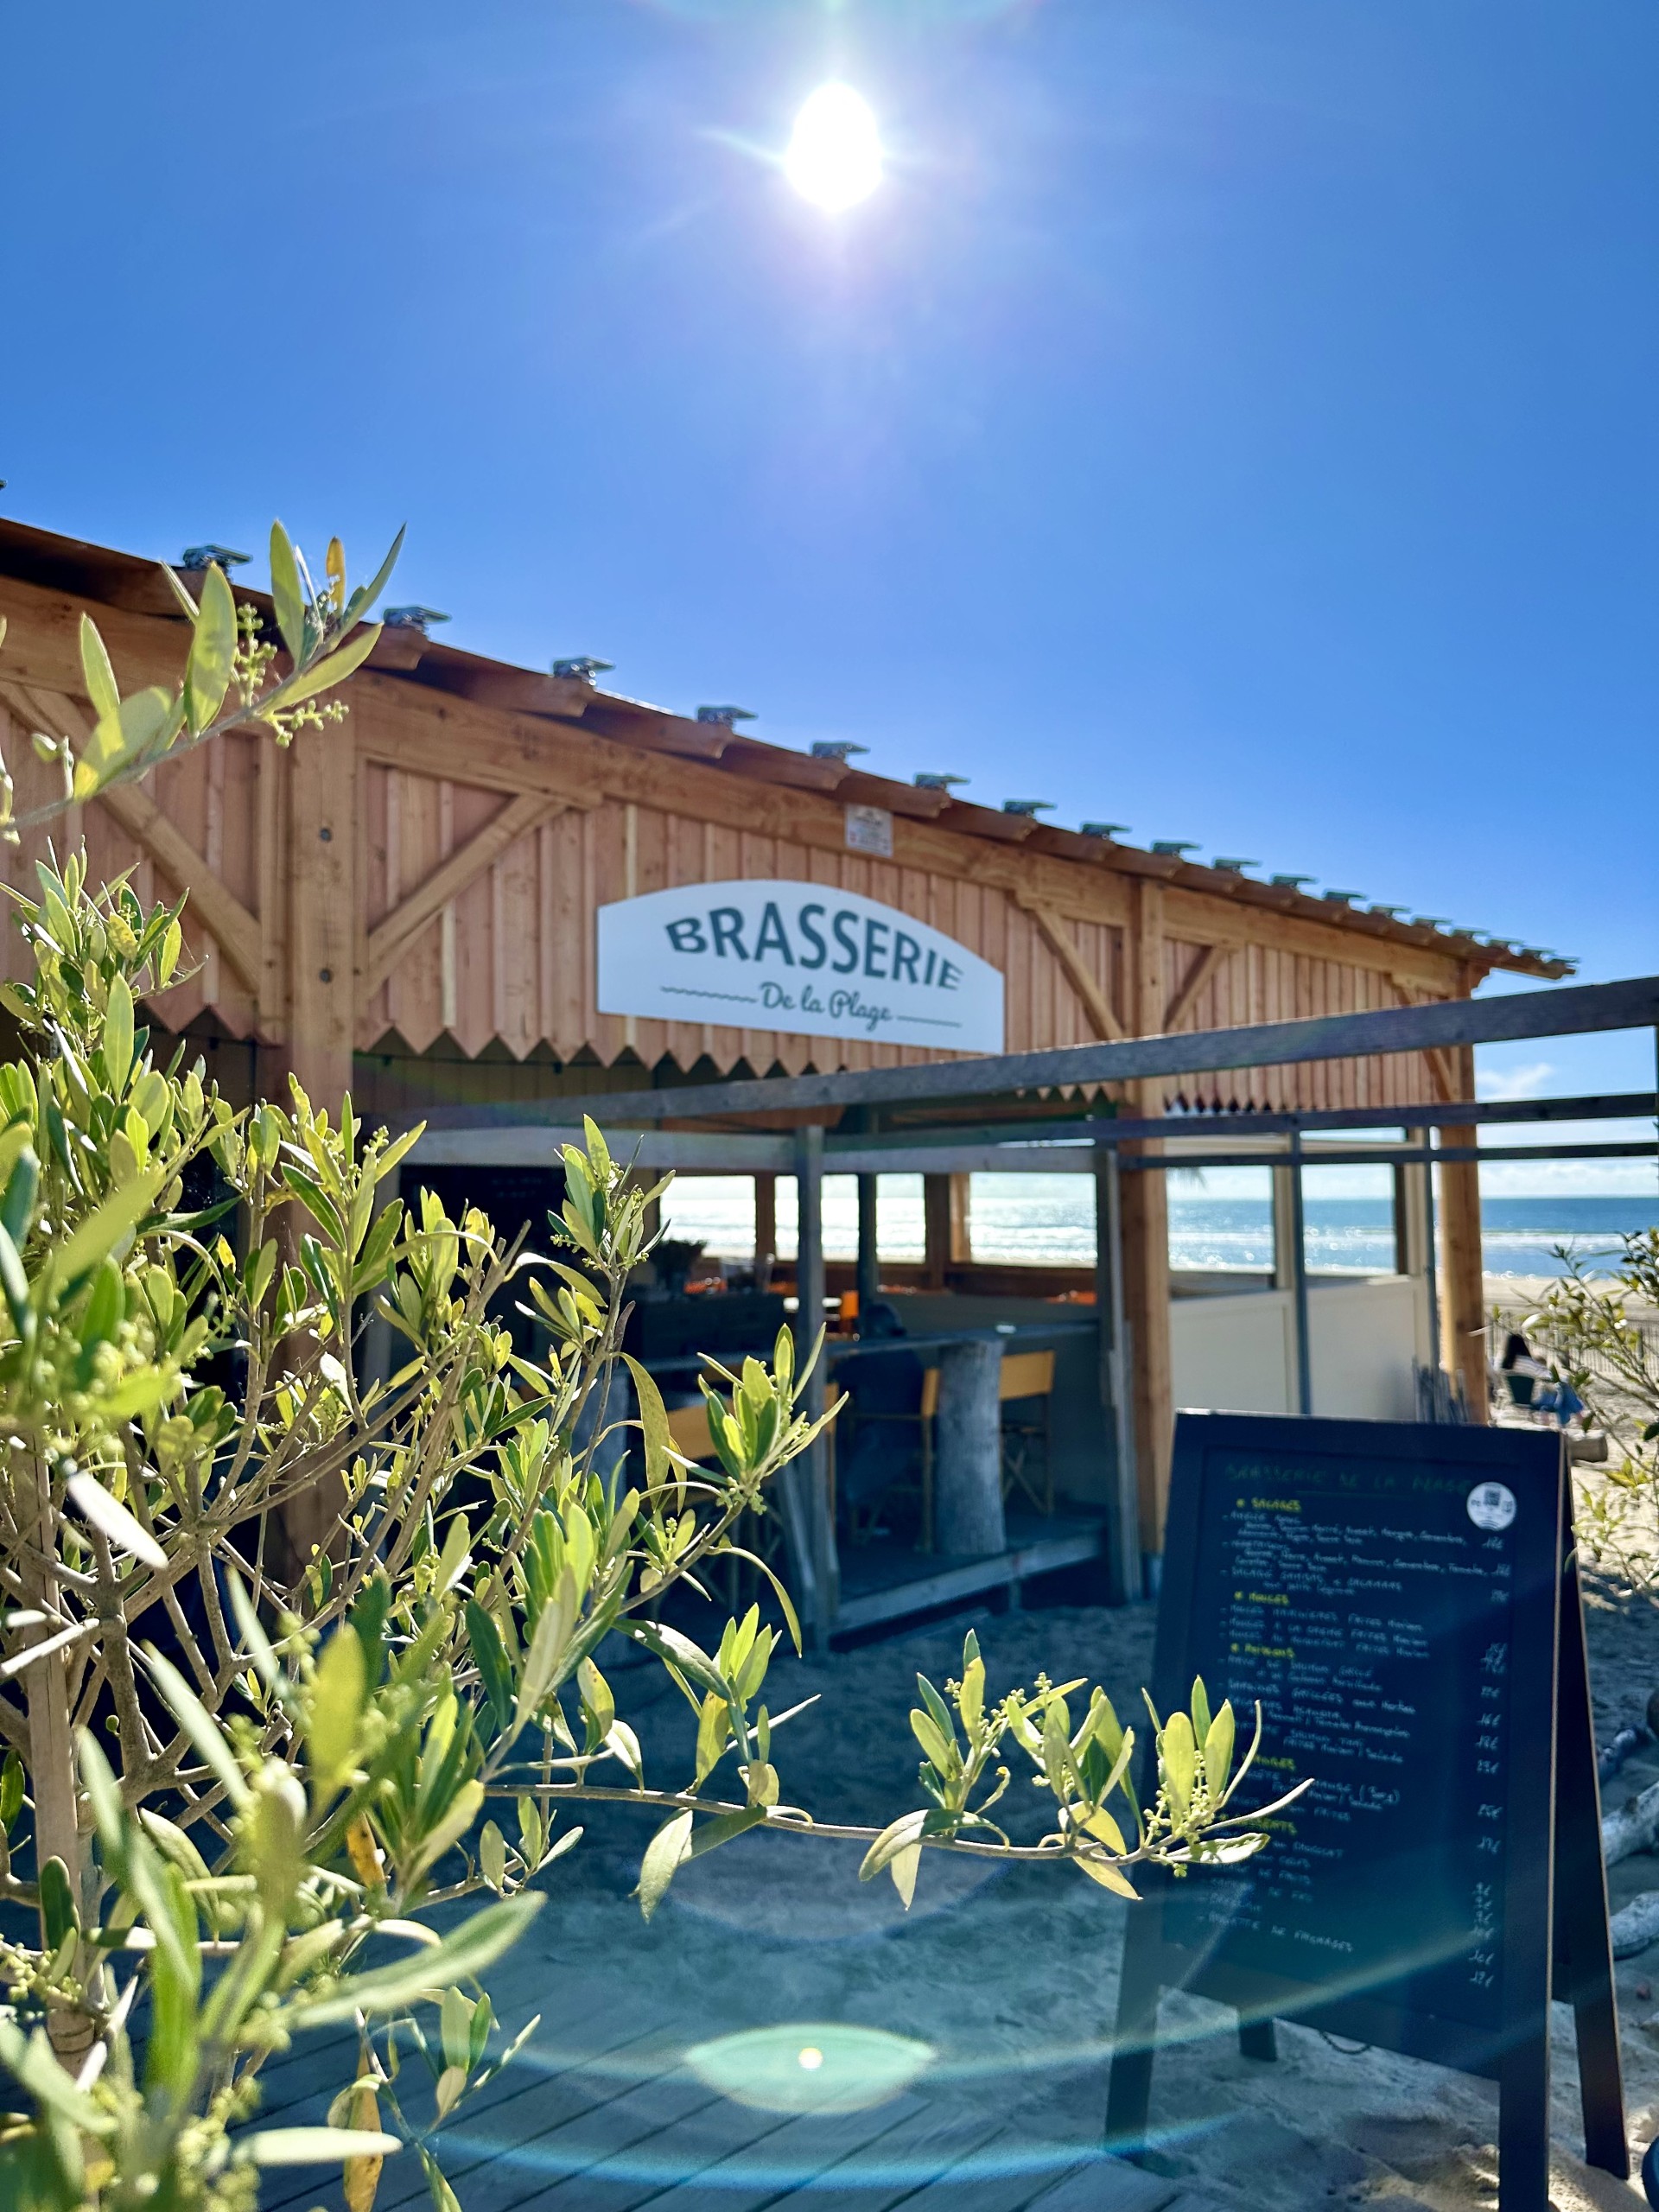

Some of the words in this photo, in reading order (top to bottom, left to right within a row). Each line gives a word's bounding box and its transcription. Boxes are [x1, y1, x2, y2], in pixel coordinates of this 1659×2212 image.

[665, 901, 963, 991] BRASSERIE
[760, 982, 794, 1010] De
[802, 985, 824, 1014] la
[830, 990, 893, 1031] Plage
